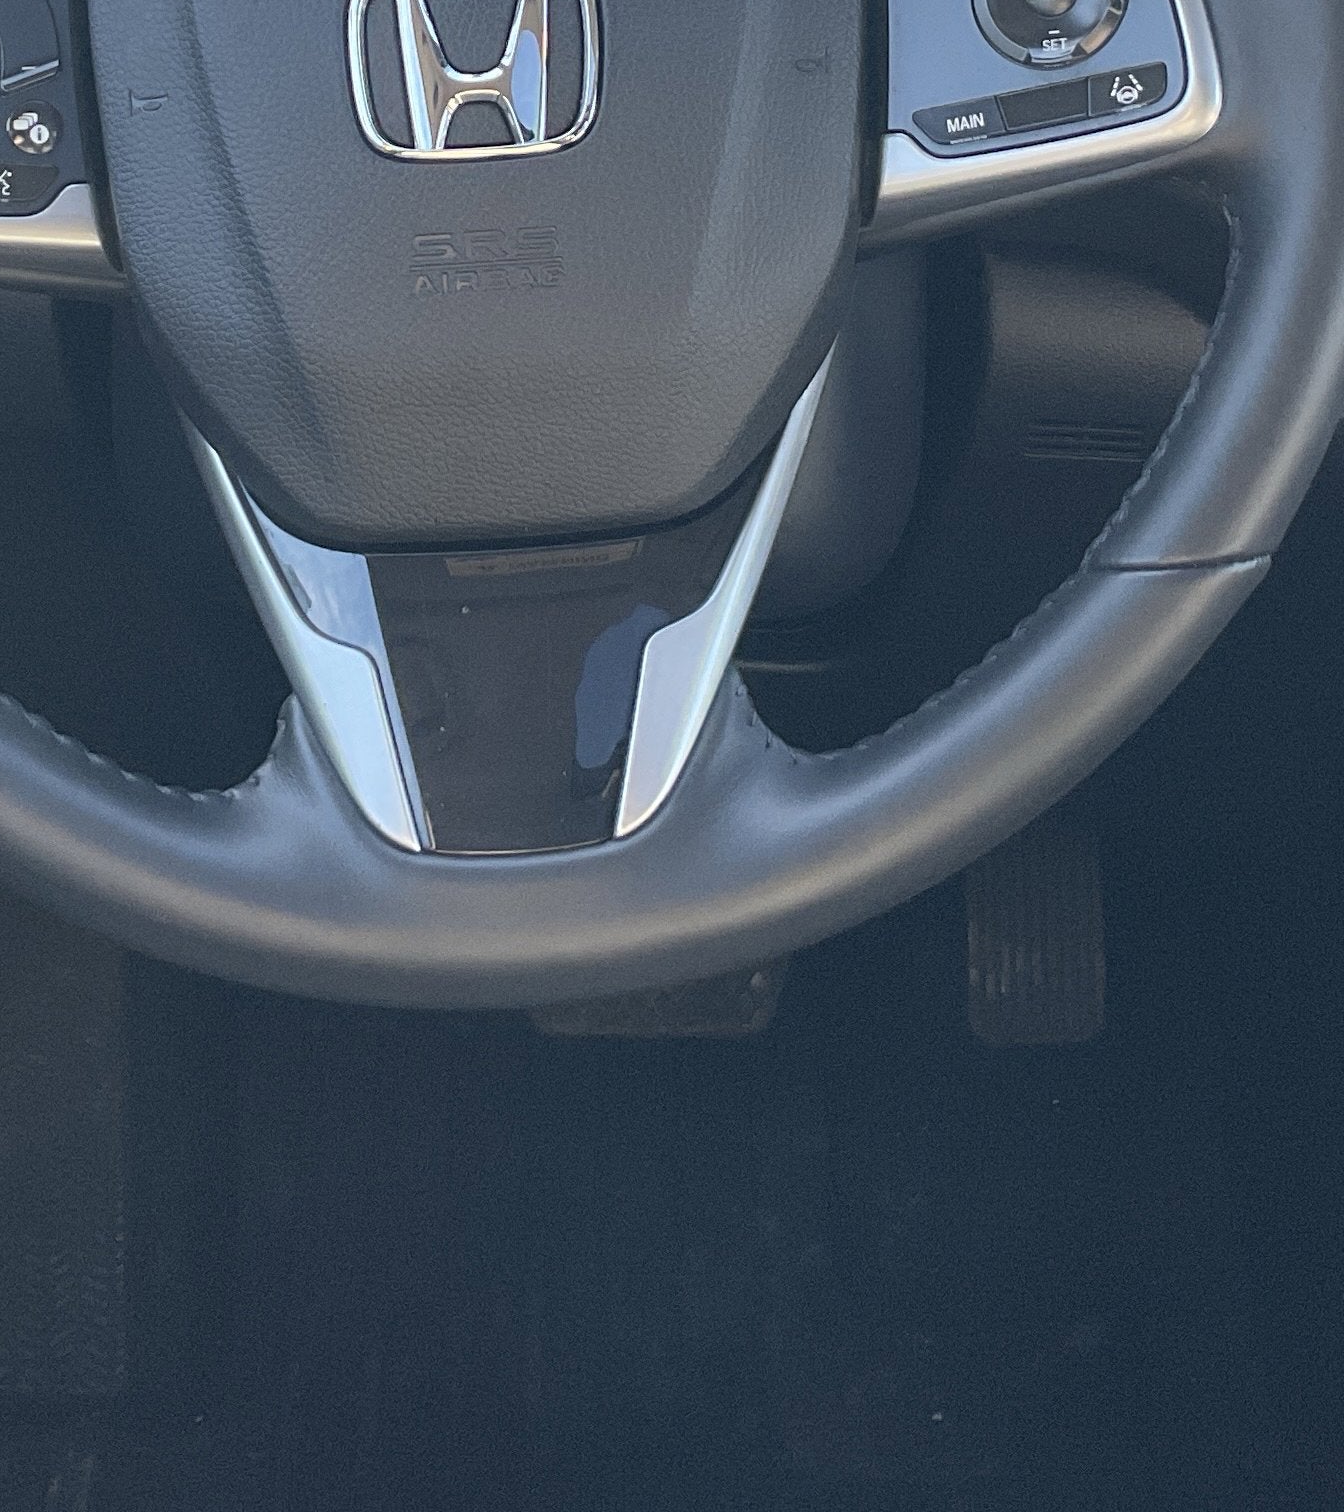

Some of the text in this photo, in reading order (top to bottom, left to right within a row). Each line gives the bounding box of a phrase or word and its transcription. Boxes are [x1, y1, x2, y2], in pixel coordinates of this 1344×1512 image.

[1042, 37, 1067, 52] SET
[946, 113, 984, 133] MAIN
[413, 225, 559, 258] SRS
[415, 264, 564, 296] AIRBAG
